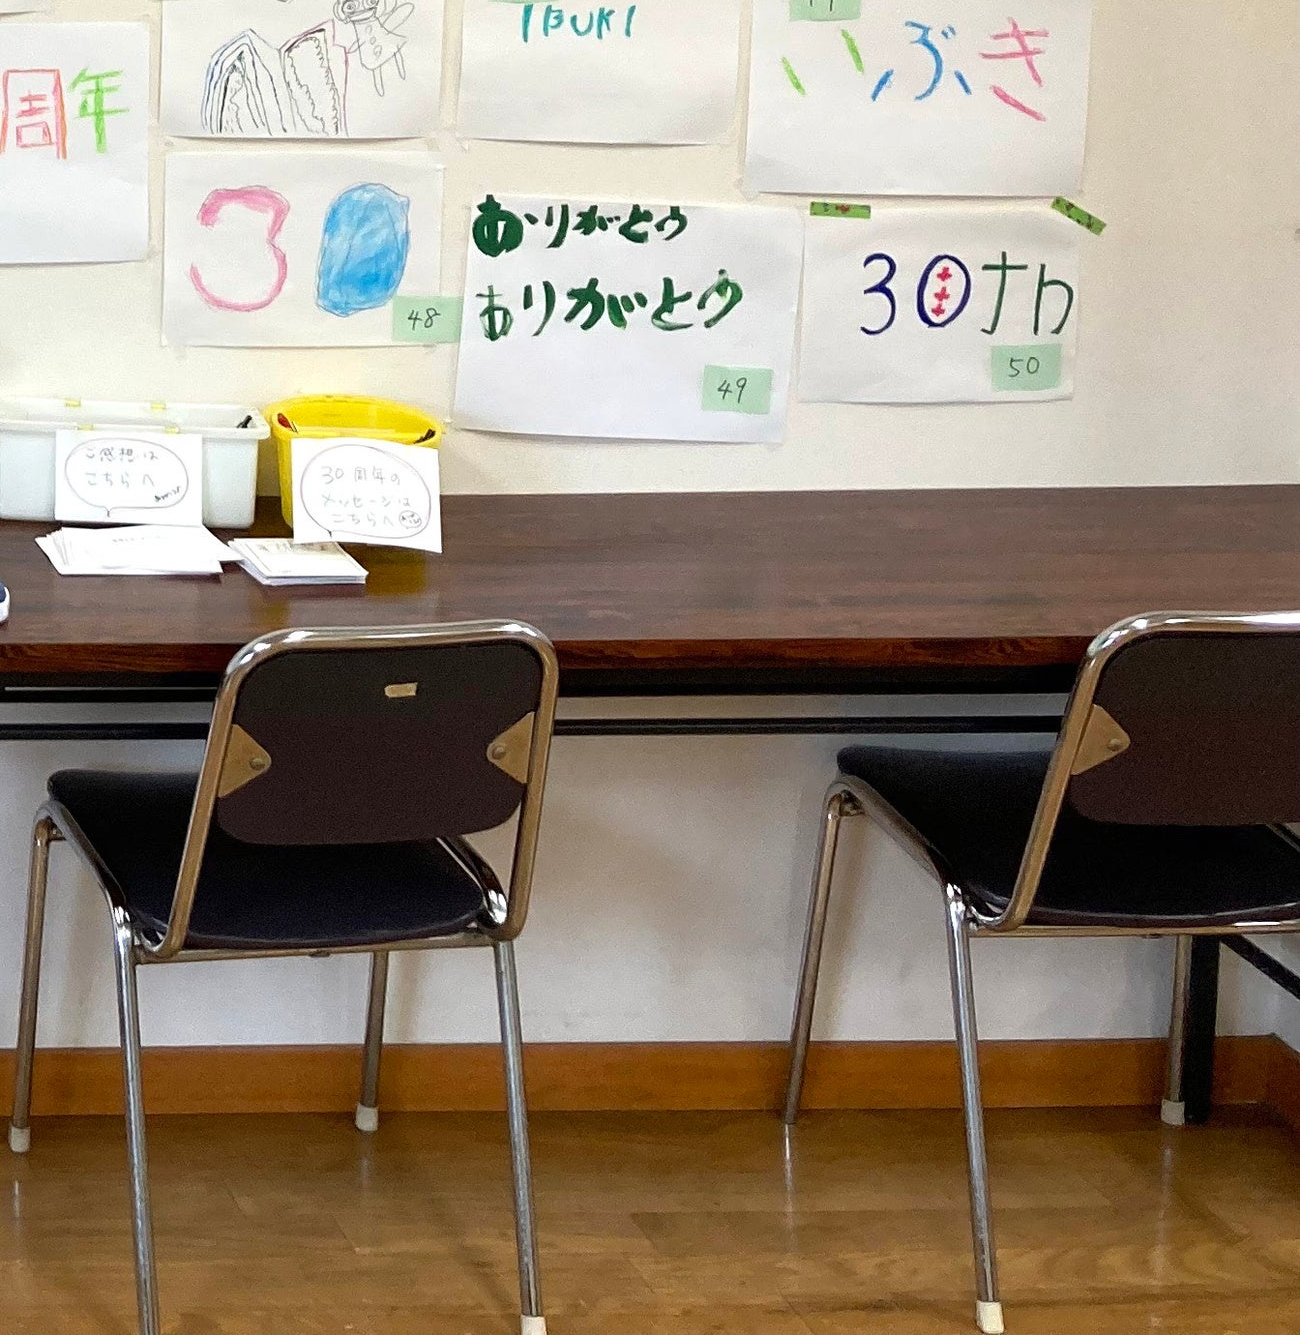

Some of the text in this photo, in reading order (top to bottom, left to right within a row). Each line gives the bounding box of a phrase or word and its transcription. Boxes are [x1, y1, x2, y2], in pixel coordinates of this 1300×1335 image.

[520, 3, 636, 42] IBUKI
[781, 17, 1049, 121] いぶき
[189, 182, 410, 318] 30
[471, 194, 690, 258] ありがとう
[407, 309, 441, 329] 48
[476, 269, 743, 342] ありがとう
[861, 251, 1074, 336] 30th
[716, 377, 749, 401] 49
[1007, 356, 1040, 377] 50
